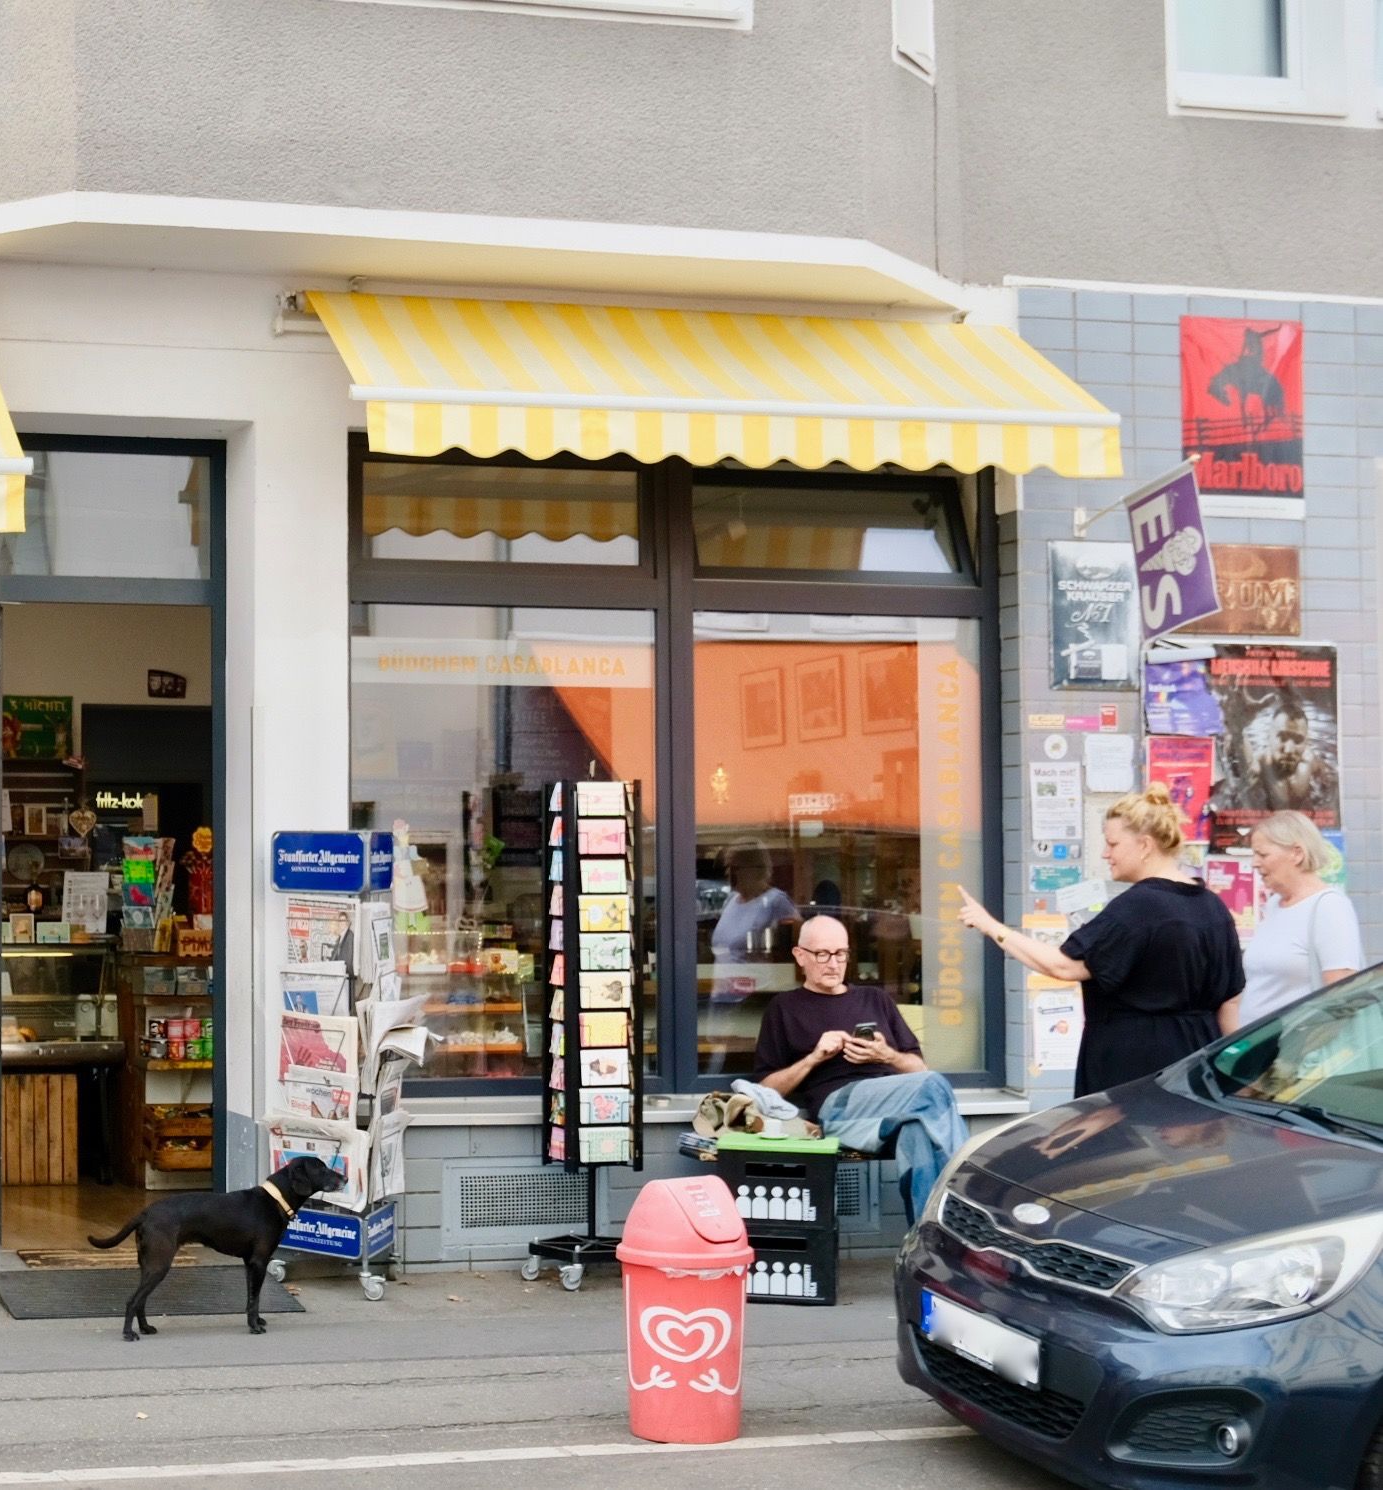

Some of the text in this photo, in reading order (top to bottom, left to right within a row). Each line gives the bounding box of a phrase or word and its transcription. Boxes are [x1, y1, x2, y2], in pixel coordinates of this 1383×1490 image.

[1187, 452, 1303, 491] Marlboro
[1058, 580, 1133, 593] SCHWARZER
[1066, 591, 1125, 602] KRAUSER
[484, 655, 627, 676] CASABLANCA
[936, 659, 963, 868] CASABLANCA
